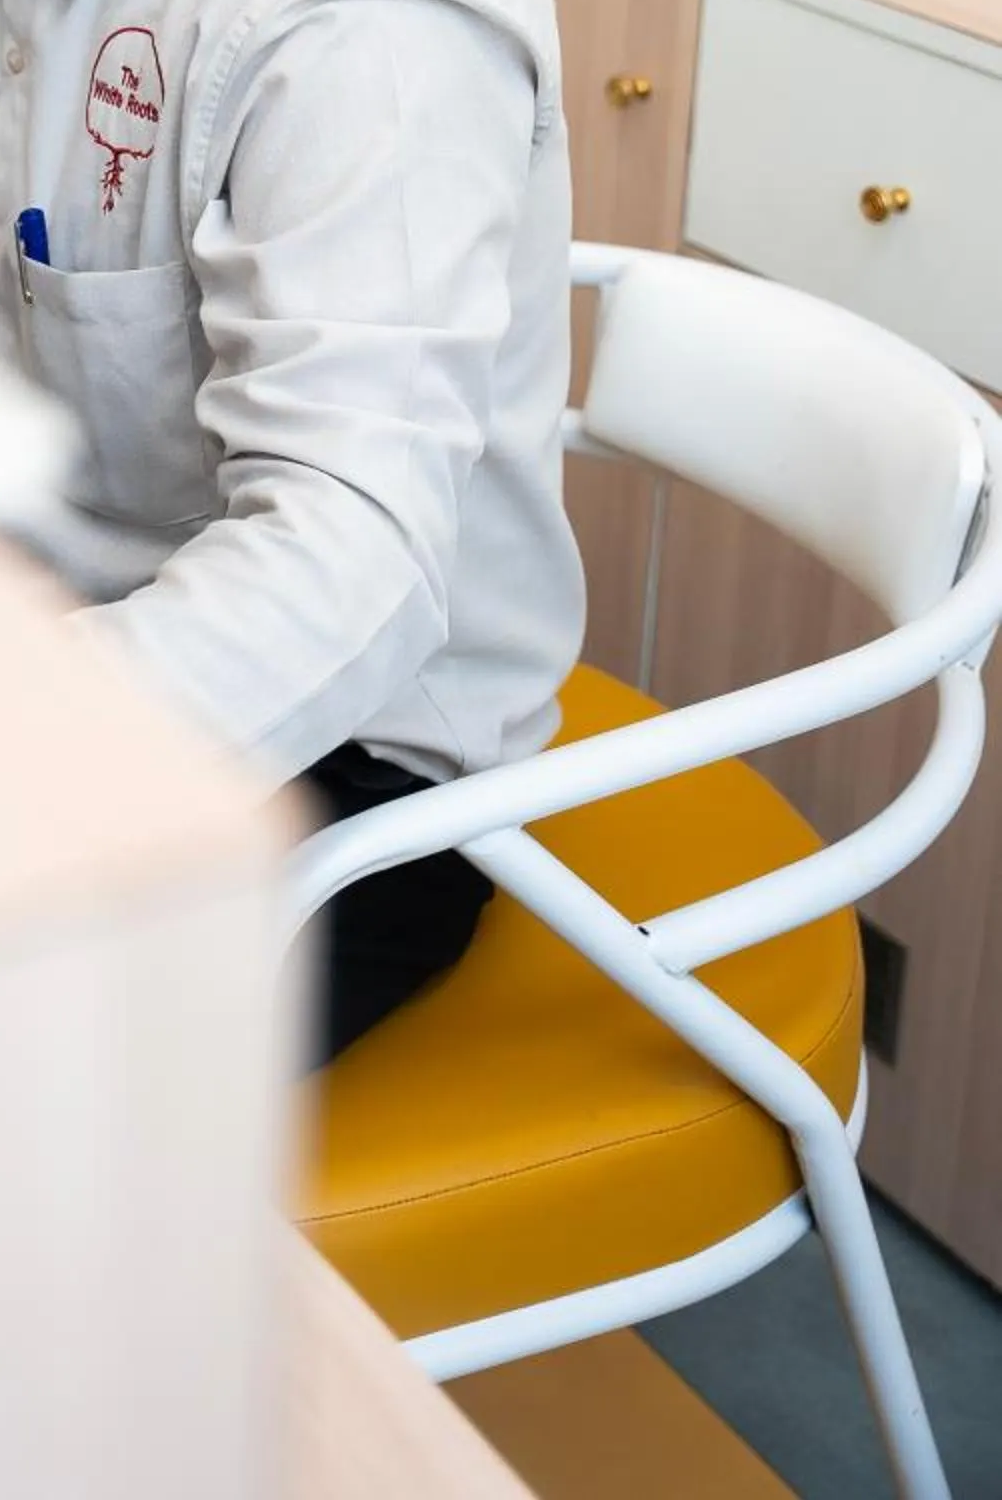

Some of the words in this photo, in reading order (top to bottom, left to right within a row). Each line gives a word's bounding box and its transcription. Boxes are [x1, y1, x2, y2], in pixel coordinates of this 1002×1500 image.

[121, 66, 139, 91] The
[93, 79, 122, 108] White
[125, 93, 159, 123] Roots
